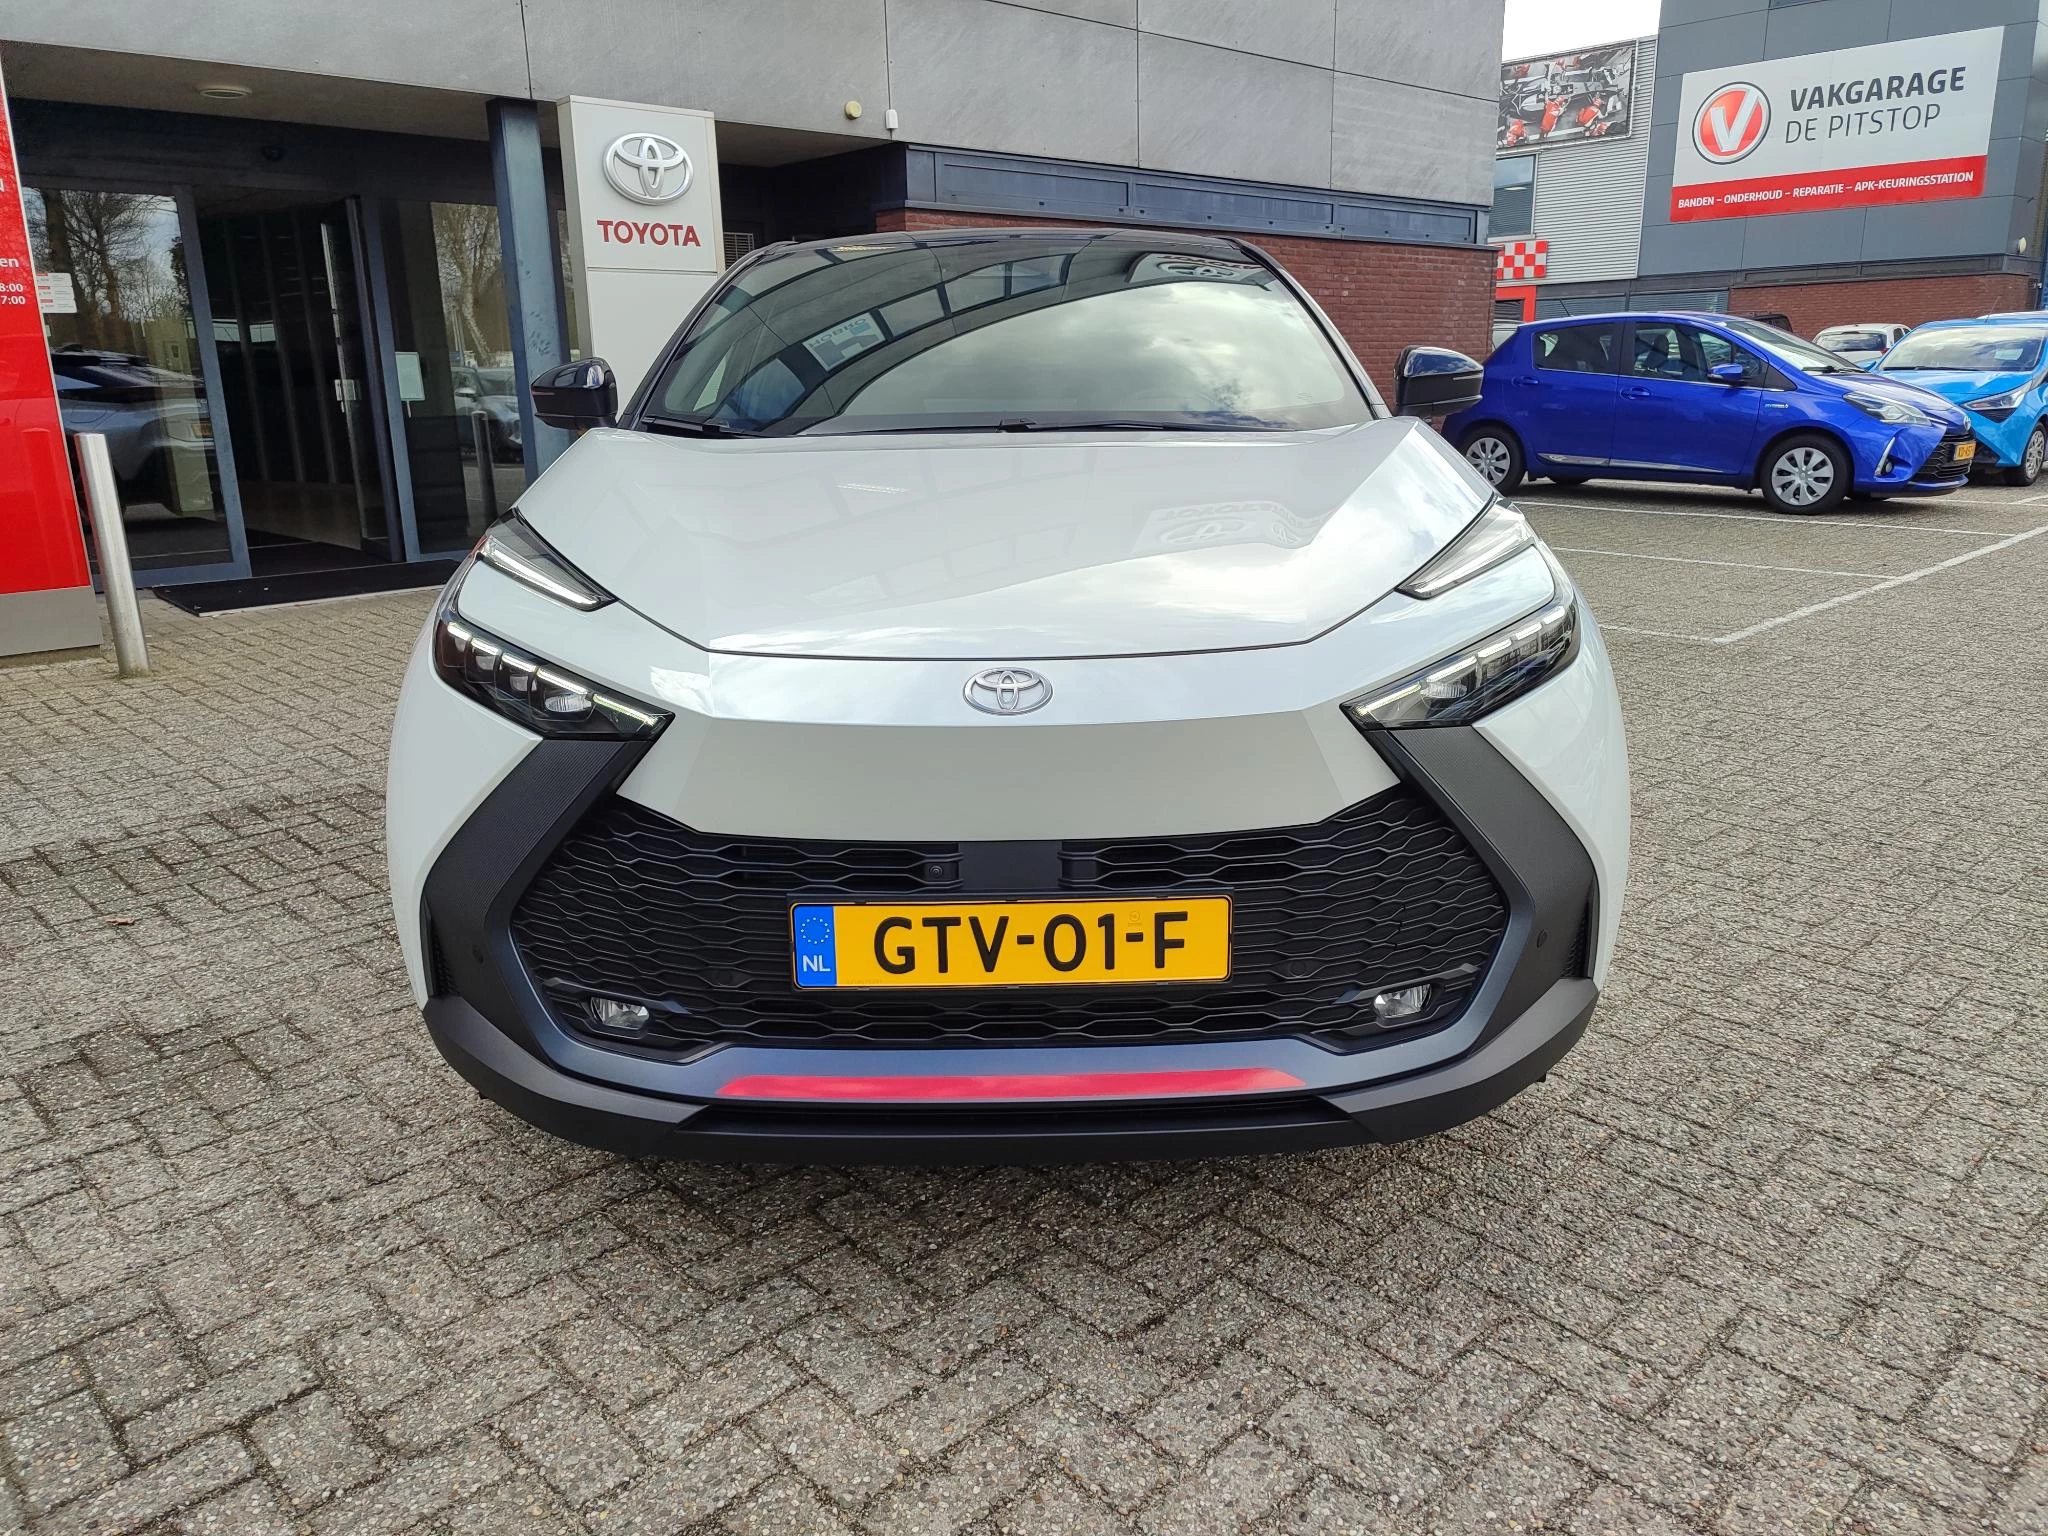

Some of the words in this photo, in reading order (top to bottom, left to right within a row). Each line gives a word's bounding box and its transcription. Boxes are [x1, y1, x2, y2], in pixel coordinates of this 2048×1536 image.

[1790, 66, 1966, 112] VAKGARAGE
[1785, 117, 1818, 144] DE
[1828, 103, 1941, 139] PITSTOP
[1678, 195, 1715, 209] BANDEN
[1724, 189, 1783, 204] ONDERHOUD
[1792, 183, 1845, 198] REPARATIE
[1854, 171, 1974, 192] APK-KEURINGSSTATION
[597, 219, 701, 247] TOYOTA
[873, 911, 1189, 975] GTV-01-F
[802, 954, 831, 973] NL
